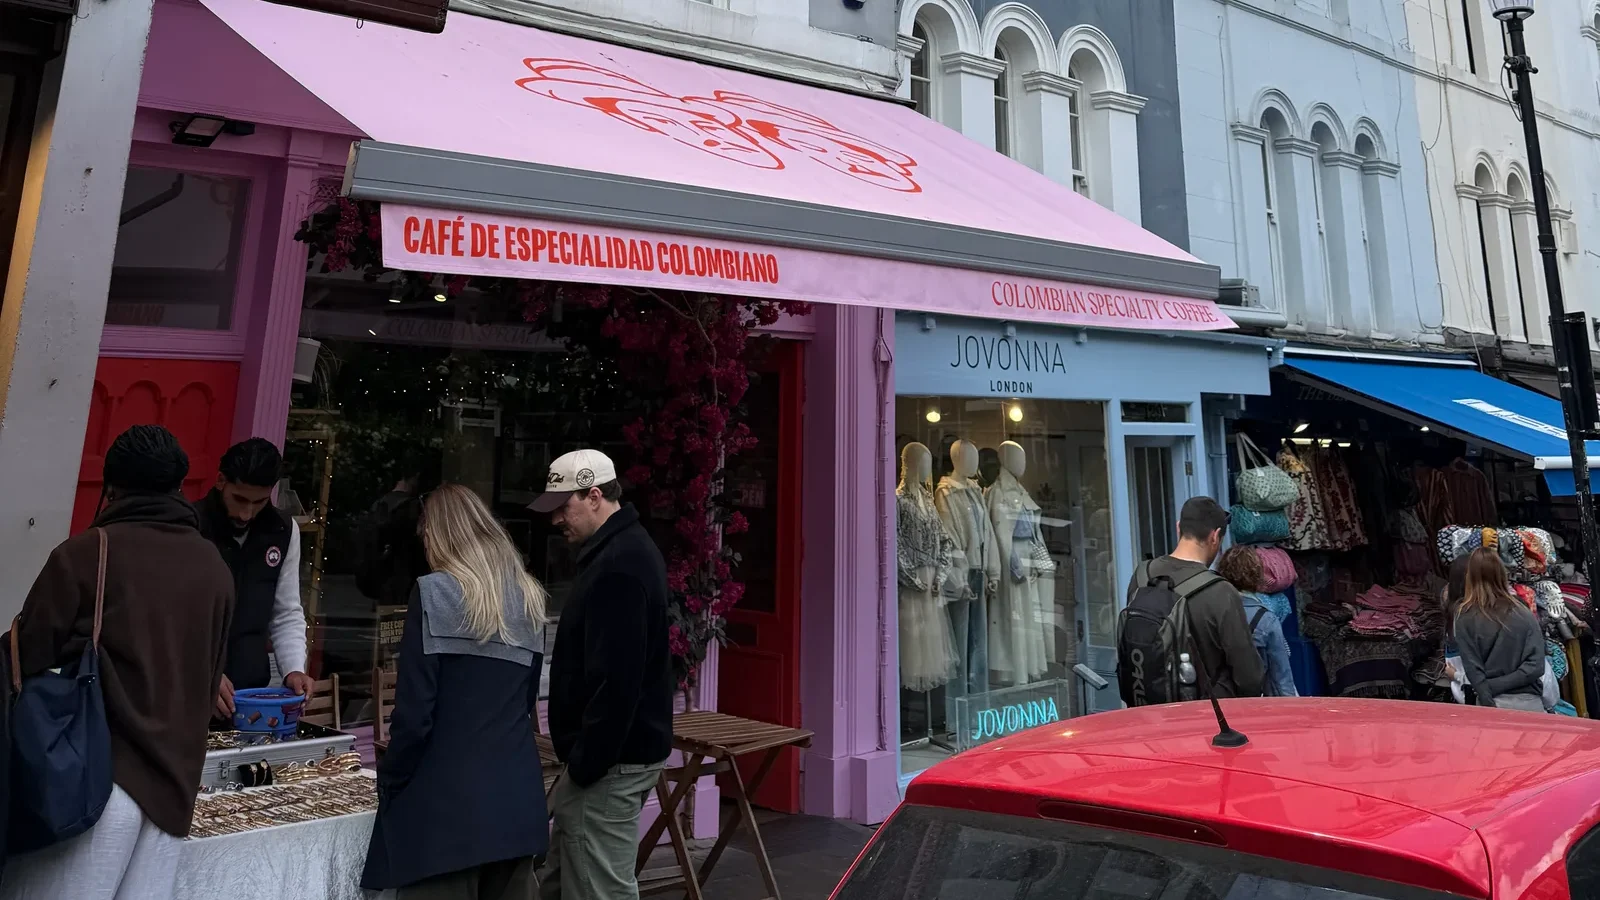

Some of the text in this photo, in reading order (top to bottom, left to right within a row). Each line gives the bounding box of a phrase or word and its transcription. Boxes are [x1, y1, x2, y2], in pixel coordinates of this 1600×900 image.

[404, 216, 779, 284] CAFÉ DE ESPECIALIDAD COLOMBIANO
[991, 281, 1219, 323] COLOMBIAN SPECIALTY COFFEE
[950, 335, 1066, 374] JOVONNA
[990, 380, 1033, 393] LONDON
[972, 697, 1059, 740] JOVONNA
